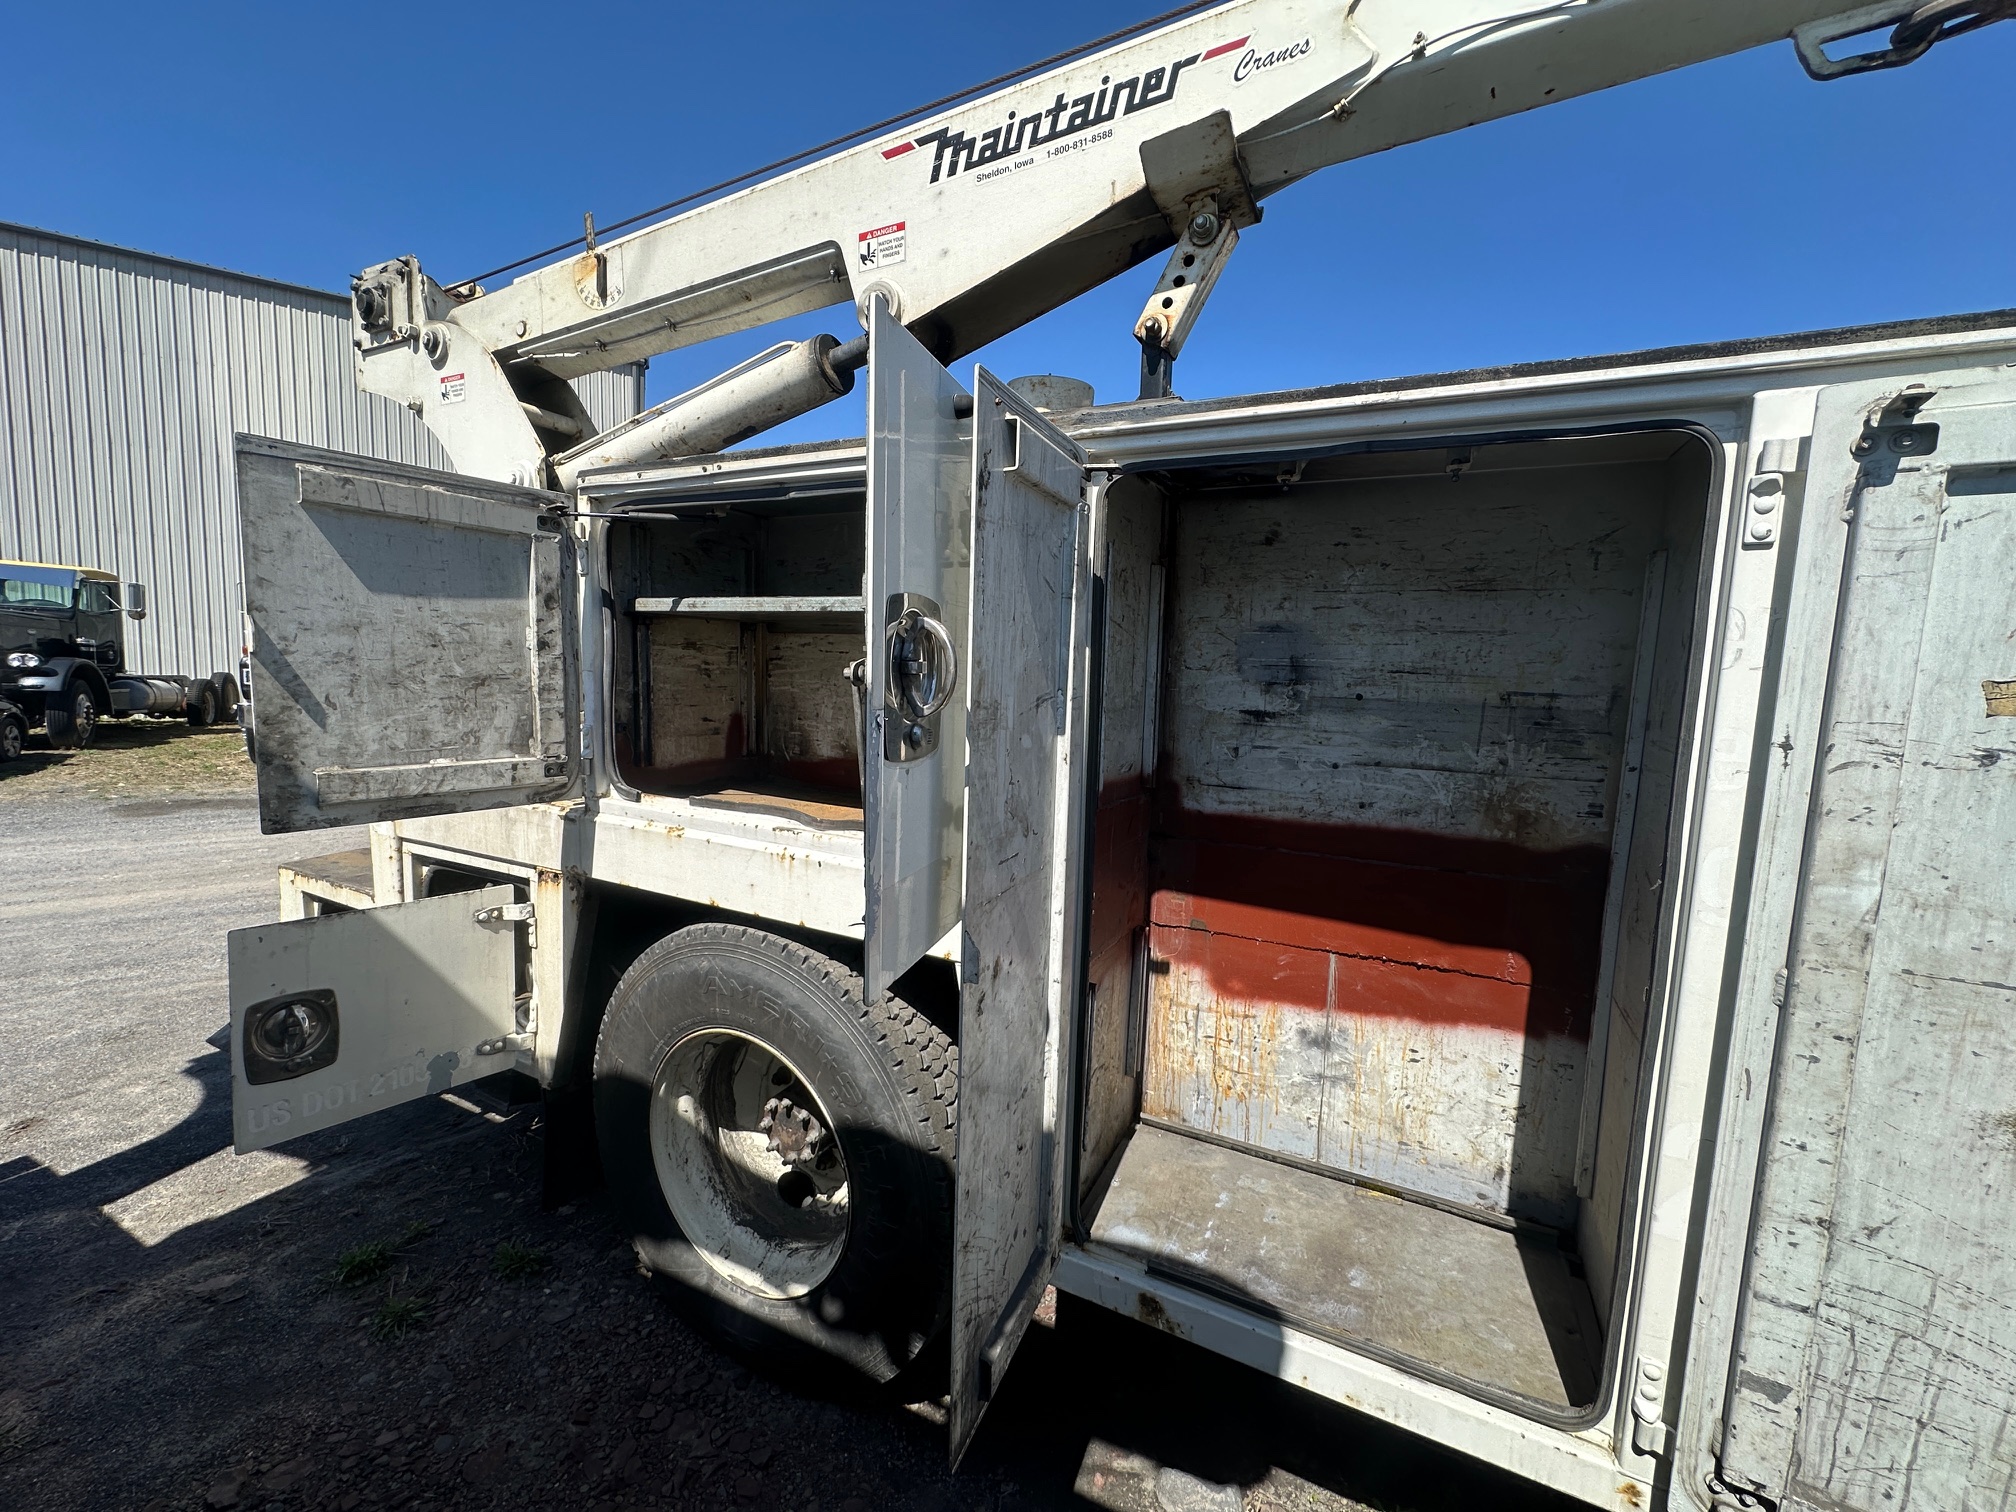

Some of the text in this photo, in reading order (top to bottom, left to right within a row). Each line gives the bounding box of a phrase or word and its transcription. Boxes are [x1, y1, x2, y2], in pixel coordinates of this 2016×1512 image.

[1234, 36, 1312, 82] Cranes
[976, 129, 1113, 183] Sheldon, Iowa 1-800-831-8588
[873, 225, 898, 238] DANGER
[247, 1098, 292, 1133] US
[302, 1080, 358, 1118] DOT
